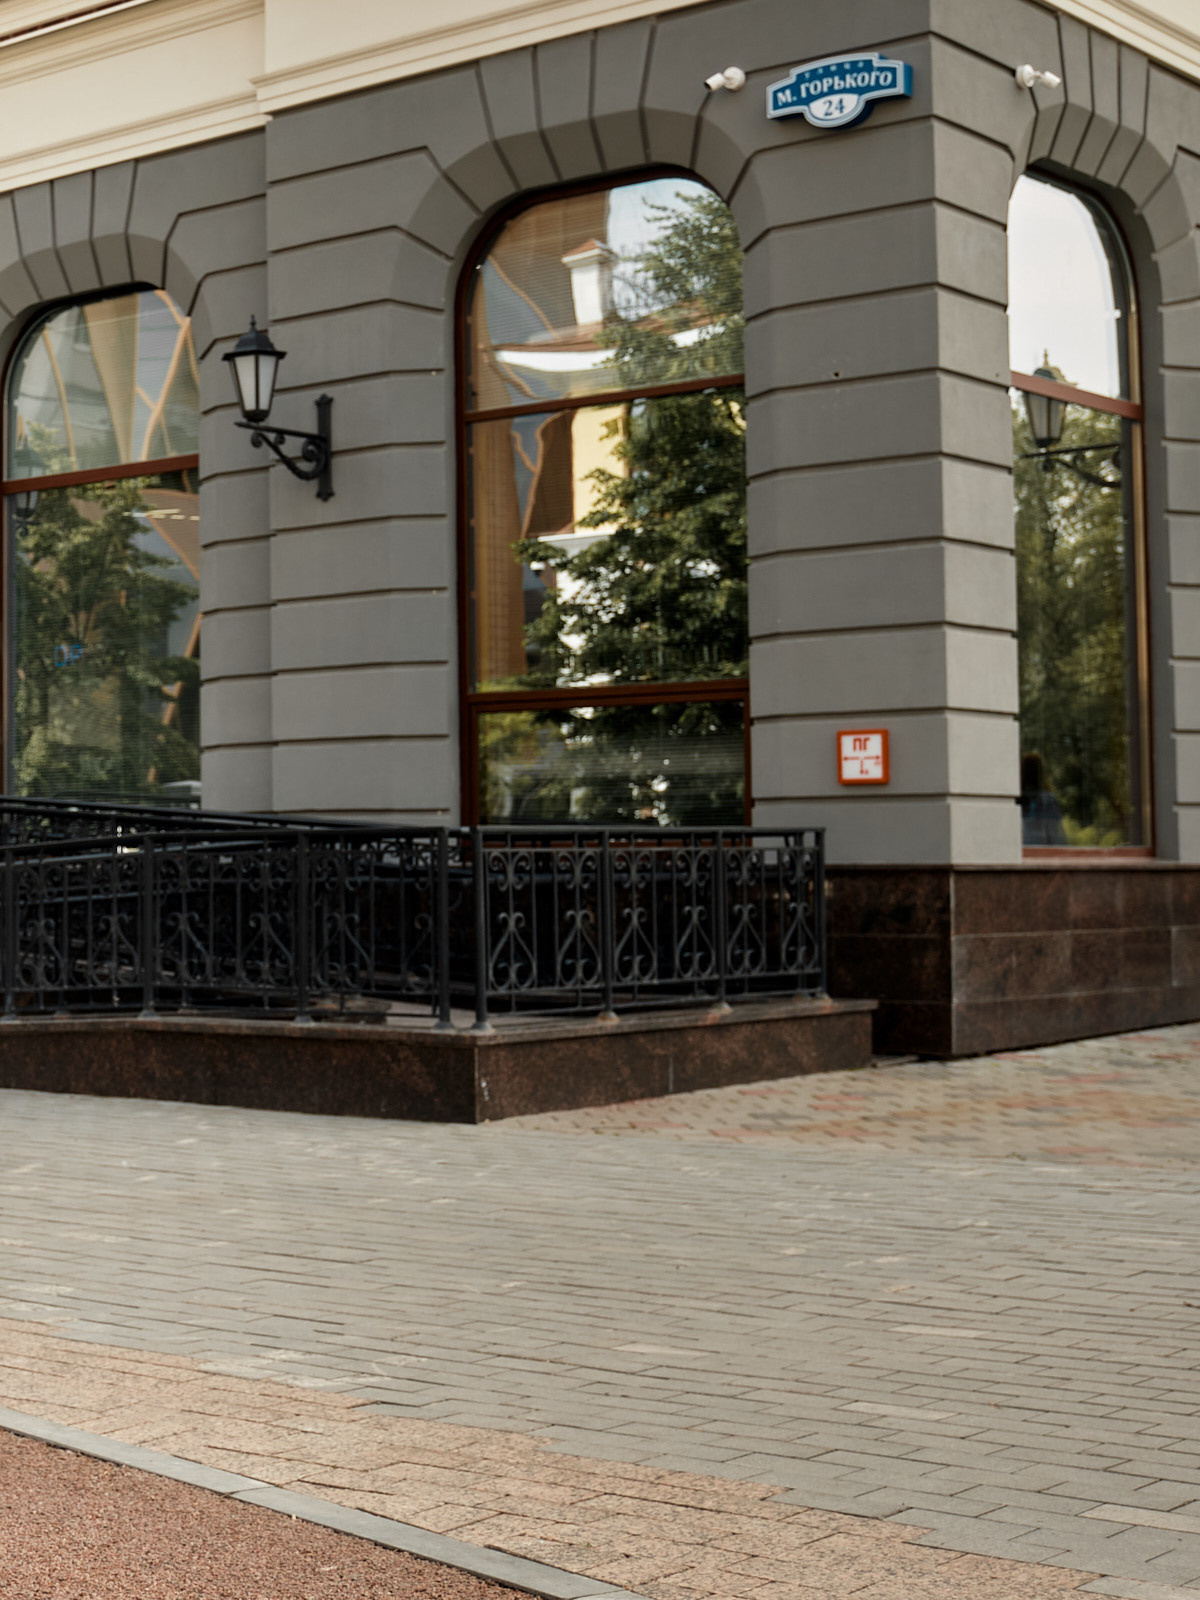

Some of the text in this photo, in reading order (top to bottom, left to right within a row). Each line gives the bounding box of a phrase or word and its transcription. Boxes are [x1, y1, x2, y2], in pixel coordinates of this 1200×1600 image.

[776, 71, 892, 106] М. ГОРЬКОГО
[823, 98, 845, 116] 24
[852, 737, 871, 751] ПГ
